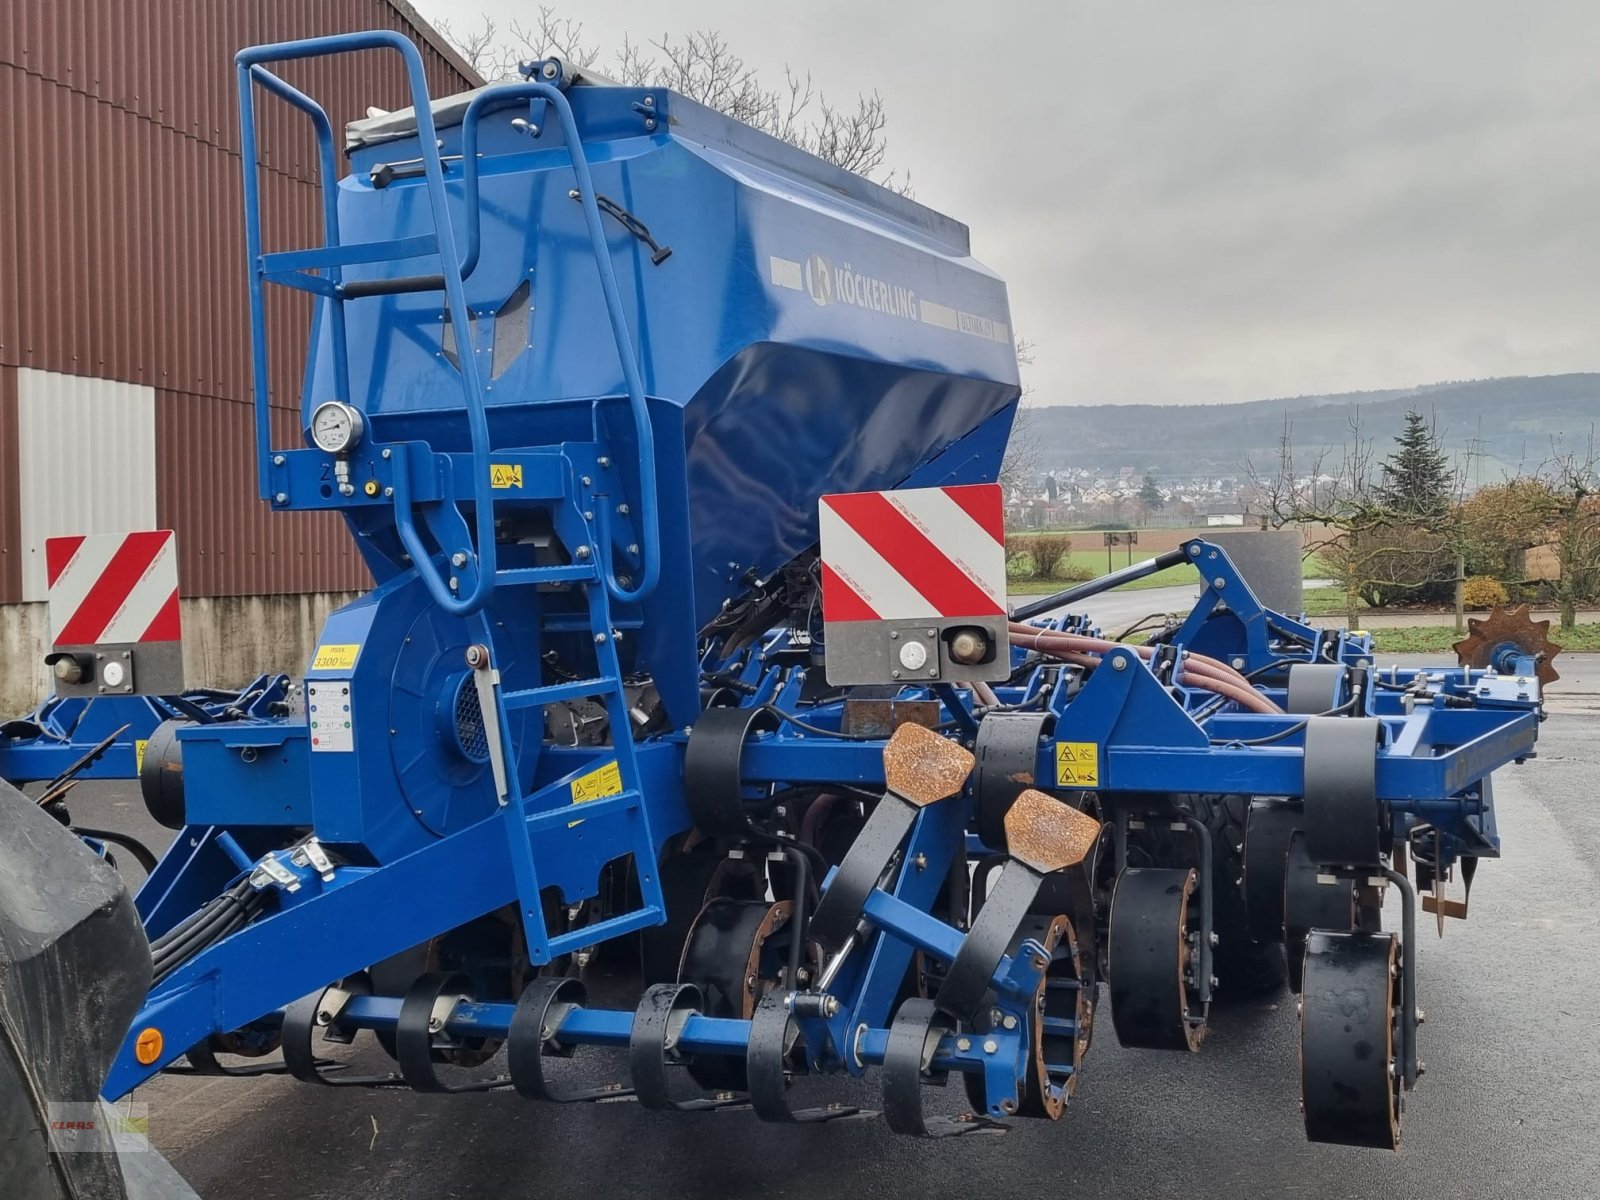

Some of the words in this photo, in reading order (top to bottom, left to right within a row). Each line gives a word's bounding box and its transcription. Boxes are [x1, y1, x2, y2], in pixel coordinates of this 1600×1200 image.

[834, 262, 917, 321] KÖCKERLING
[320, 463, 331, 481] 2
[368, 460, 375, 477] 1
[315, 657, 339, 667] 3300
